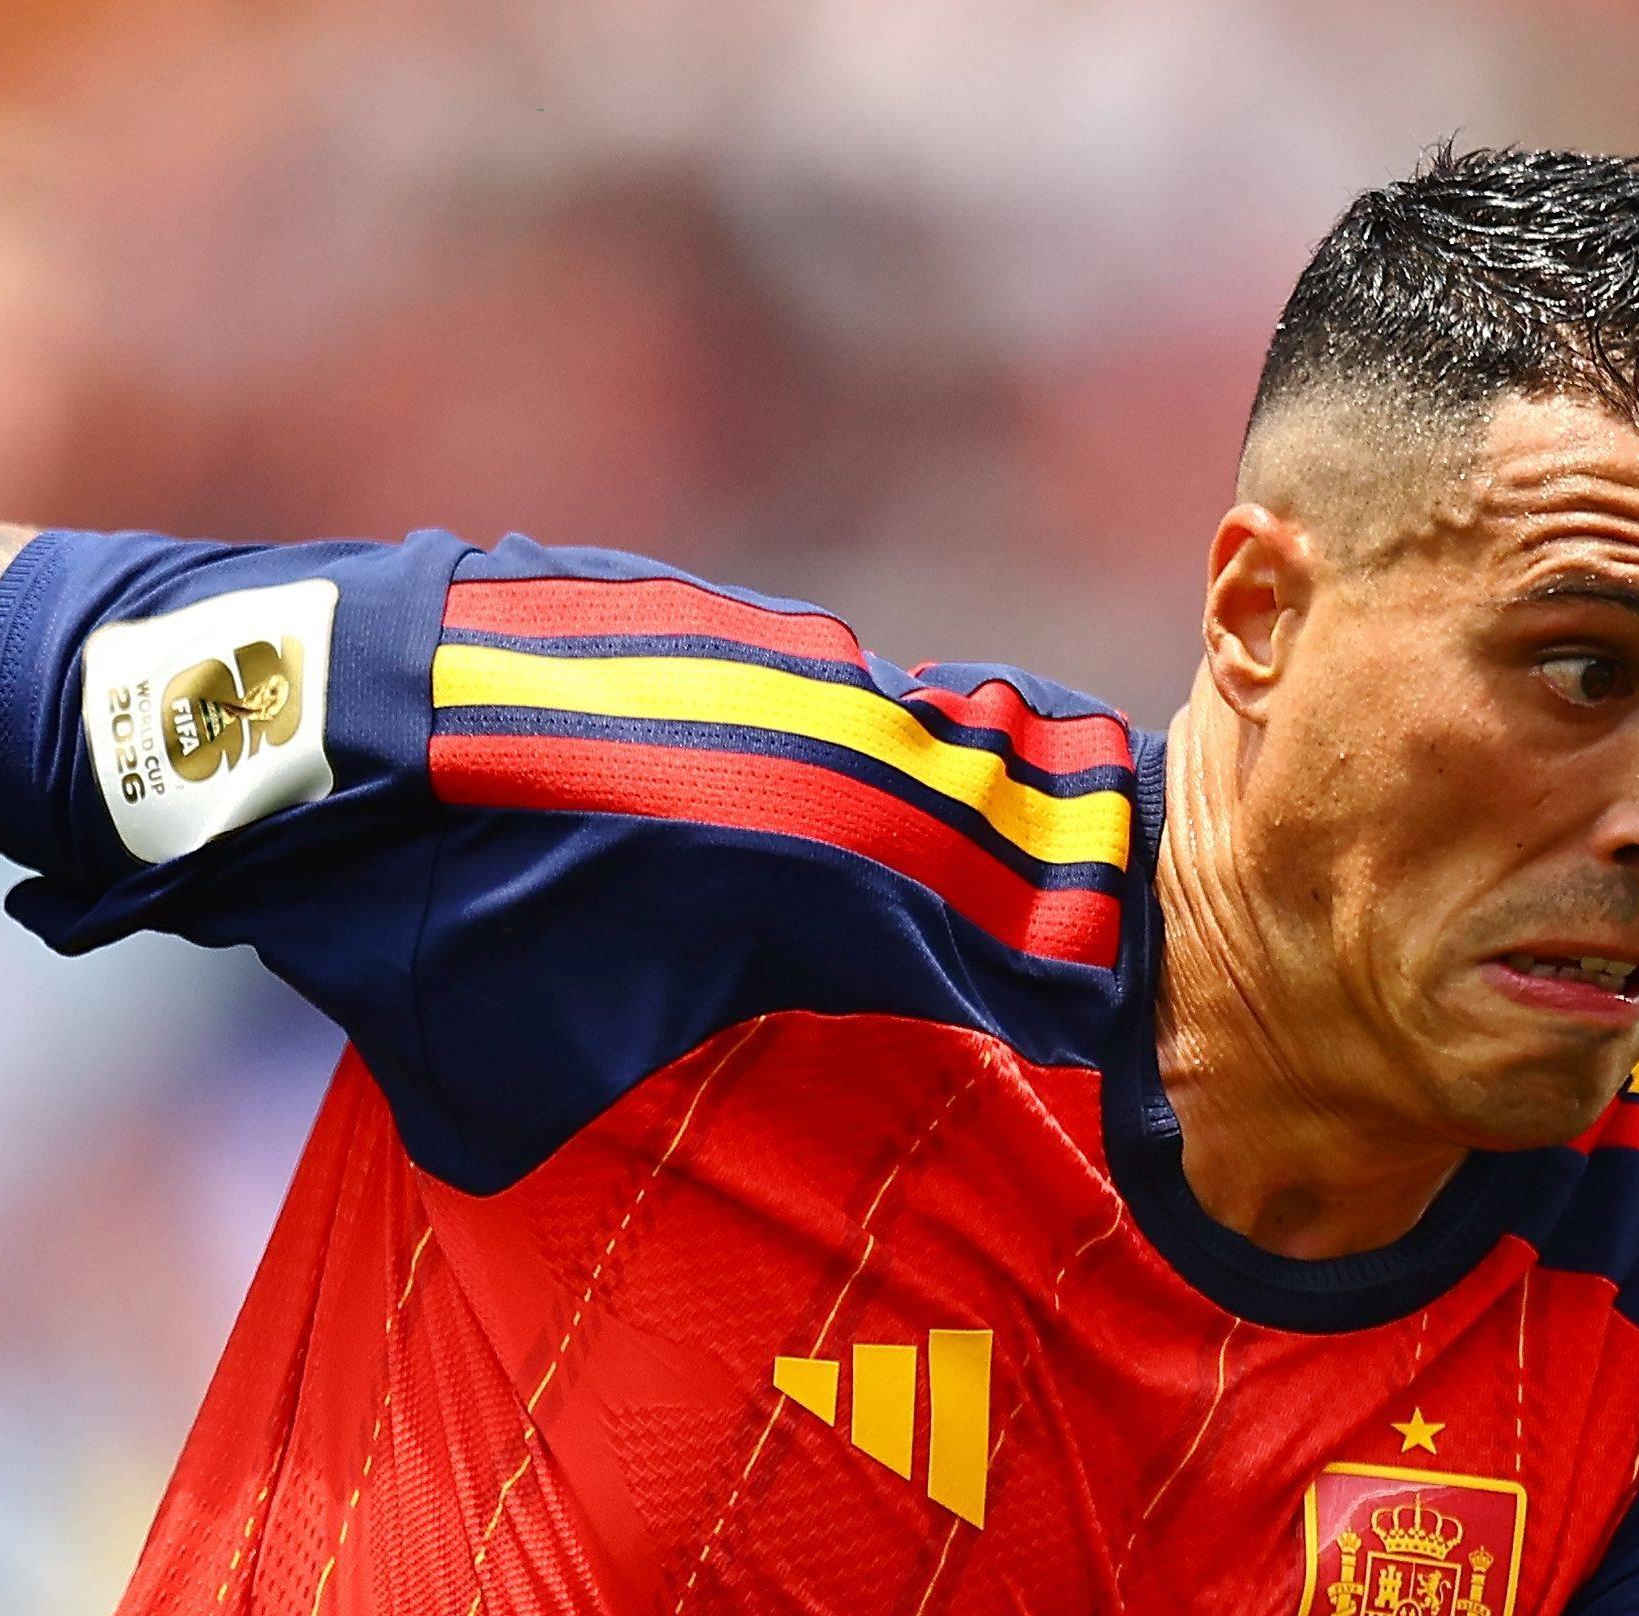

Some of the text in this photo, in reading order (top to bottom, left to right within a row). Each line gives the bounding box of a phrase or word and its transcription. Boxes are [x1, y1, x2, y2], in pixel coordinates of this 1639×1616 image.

[108, 686, 146, 804] 2026
[136, 679, 166, 796] WORLD CUP
[170, 697, 200, 757] FIFA
